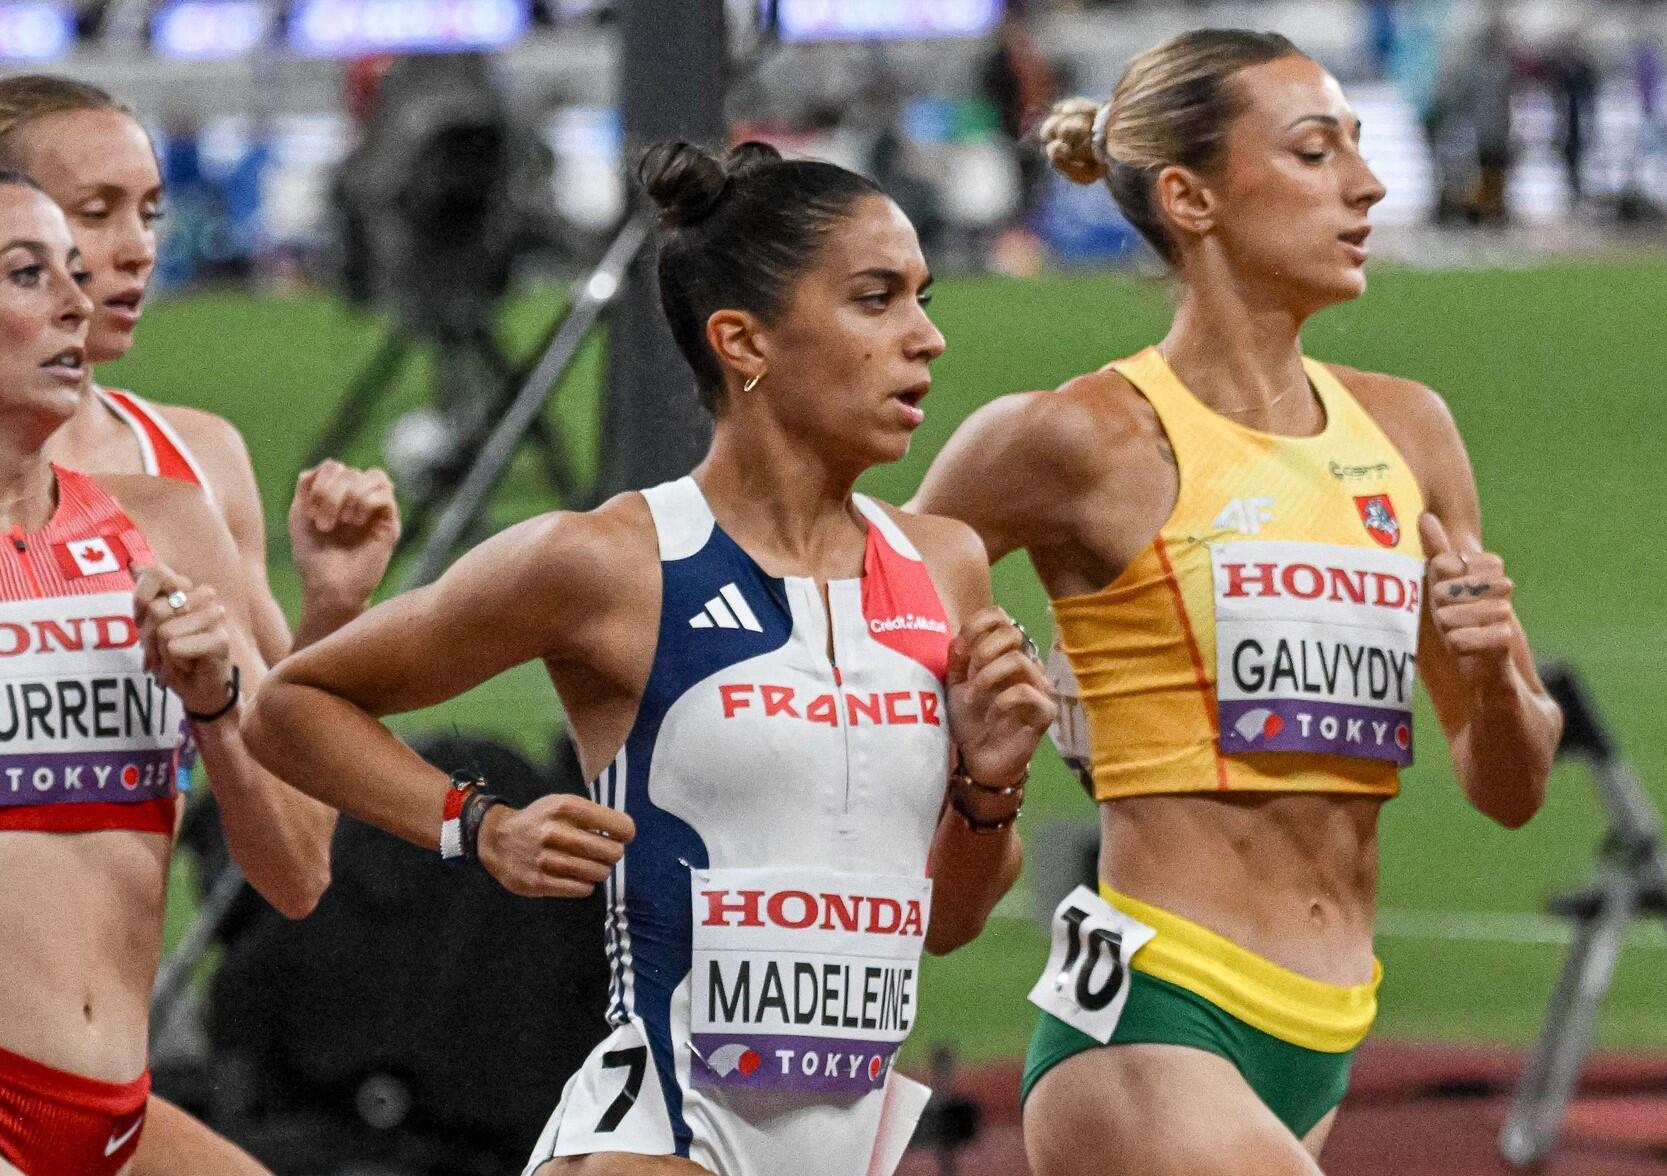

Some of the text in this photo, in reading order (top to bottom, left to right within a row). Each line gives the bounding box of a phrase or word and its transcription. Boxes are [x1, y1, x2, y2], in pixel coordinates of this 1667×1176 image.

[1231, 638, 1416, 703] GALVYDY
[718, 684, 941, 727] FRANCE
[701, 890, 923, 936] HONDA
[1060, 905, 1124, 1012] 10
[708, 959, 913, 1031] MADELEINE
[593, 1045, 648, 1134] 7
